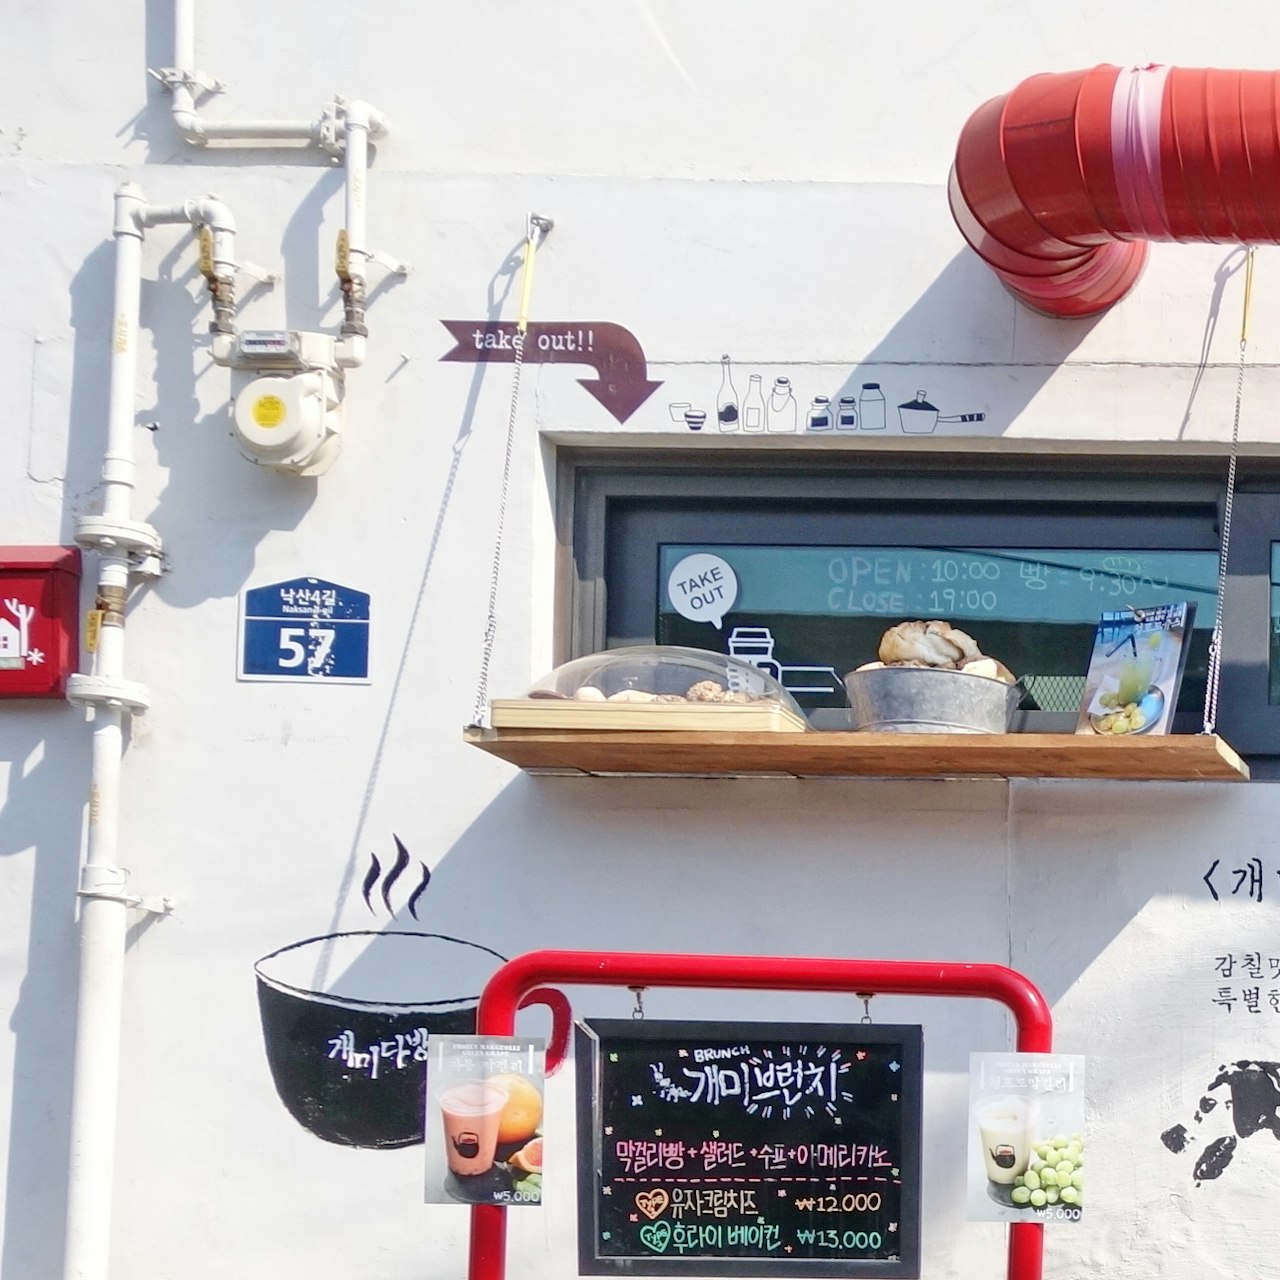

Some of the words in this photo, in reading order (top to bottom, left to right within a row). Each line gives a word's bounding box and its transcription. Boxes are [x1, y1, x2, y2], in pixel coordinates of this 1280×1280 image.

[472, 329, 521, 350] take
[537, 330, 594, 351] out!!
[676, 567, 724, 596] TAKE
[828, 557, 913, 586] OPEN
[931, 559, 1000, 583] 10:00
[1019, 561, 1051, 591] 빵
[280, 588, 336, 606] 낙산4길
[690, 585, 725, 610] OUT
[827, 587, 906, 613] CLOSE
[928, 589, 997, 613] 19:00
[278, 628, 335, 668] 57
[694, 1045, 751, 1063] BRUNCH
[670, 1188, 759, 1219] 유자크림치즈
[672, 1222, 723, 1254] 후라이
[728, 1225, 782, 1251] 베이컨
